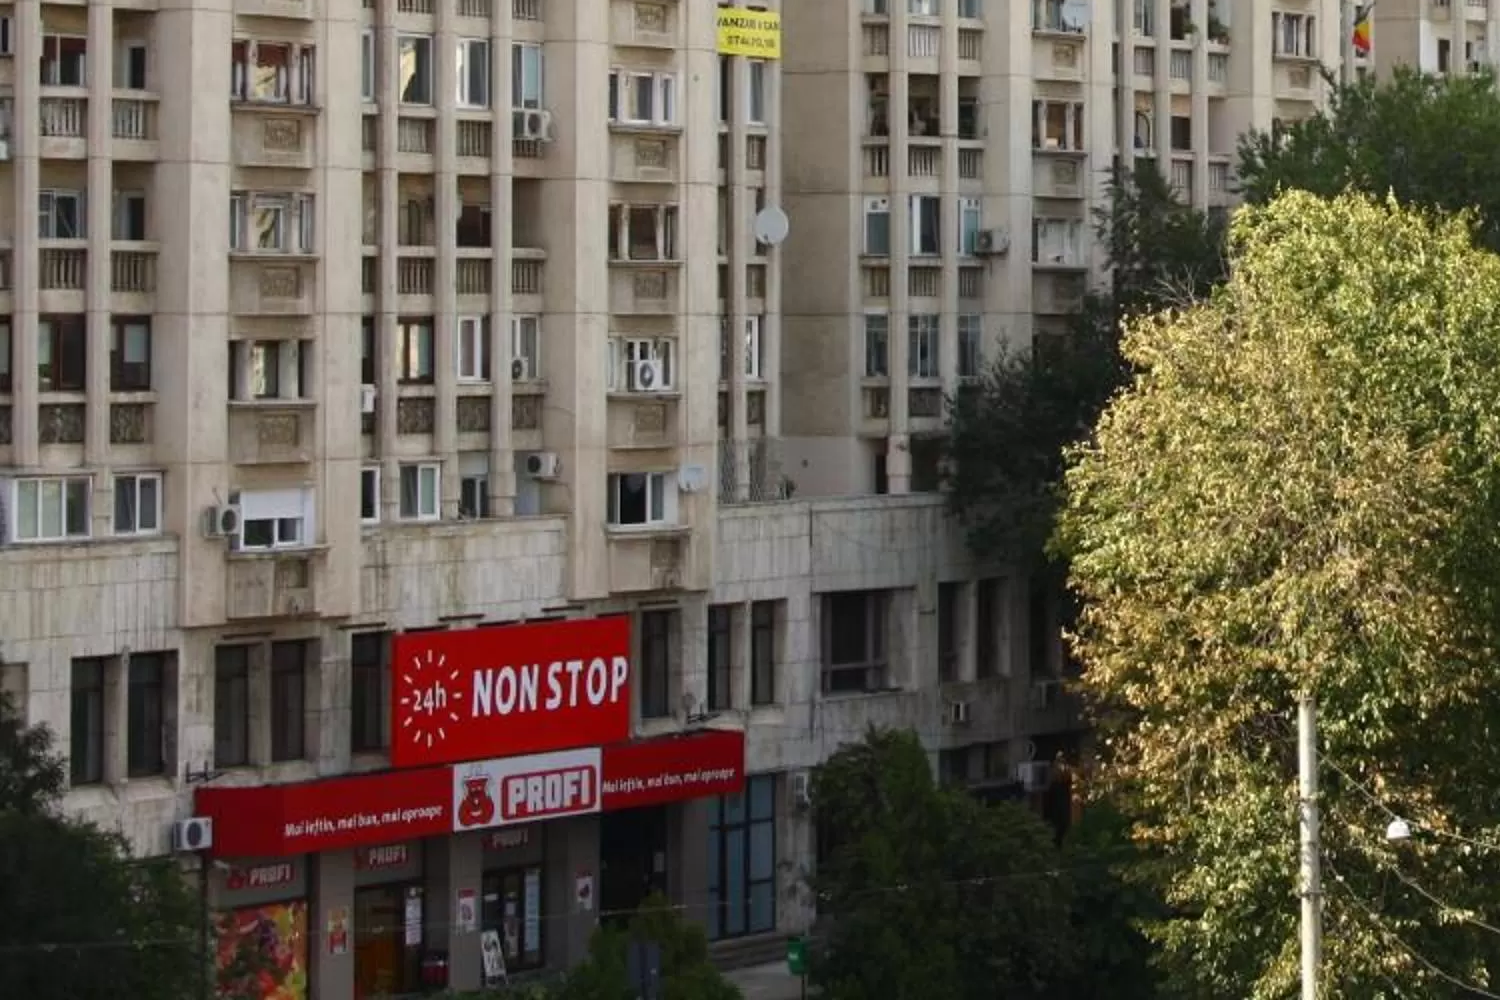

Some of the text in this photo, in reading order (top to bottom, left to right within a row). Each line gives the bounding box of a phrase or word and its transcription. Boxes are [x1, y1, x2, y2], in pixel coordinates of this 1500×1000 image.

[412, 656, 628, 717] 24h NON STOP
[507, 769, 590, 816] PROFI
[369, 845, 408, 865] PROFI
[250, 864, 292, 885] PROFI
